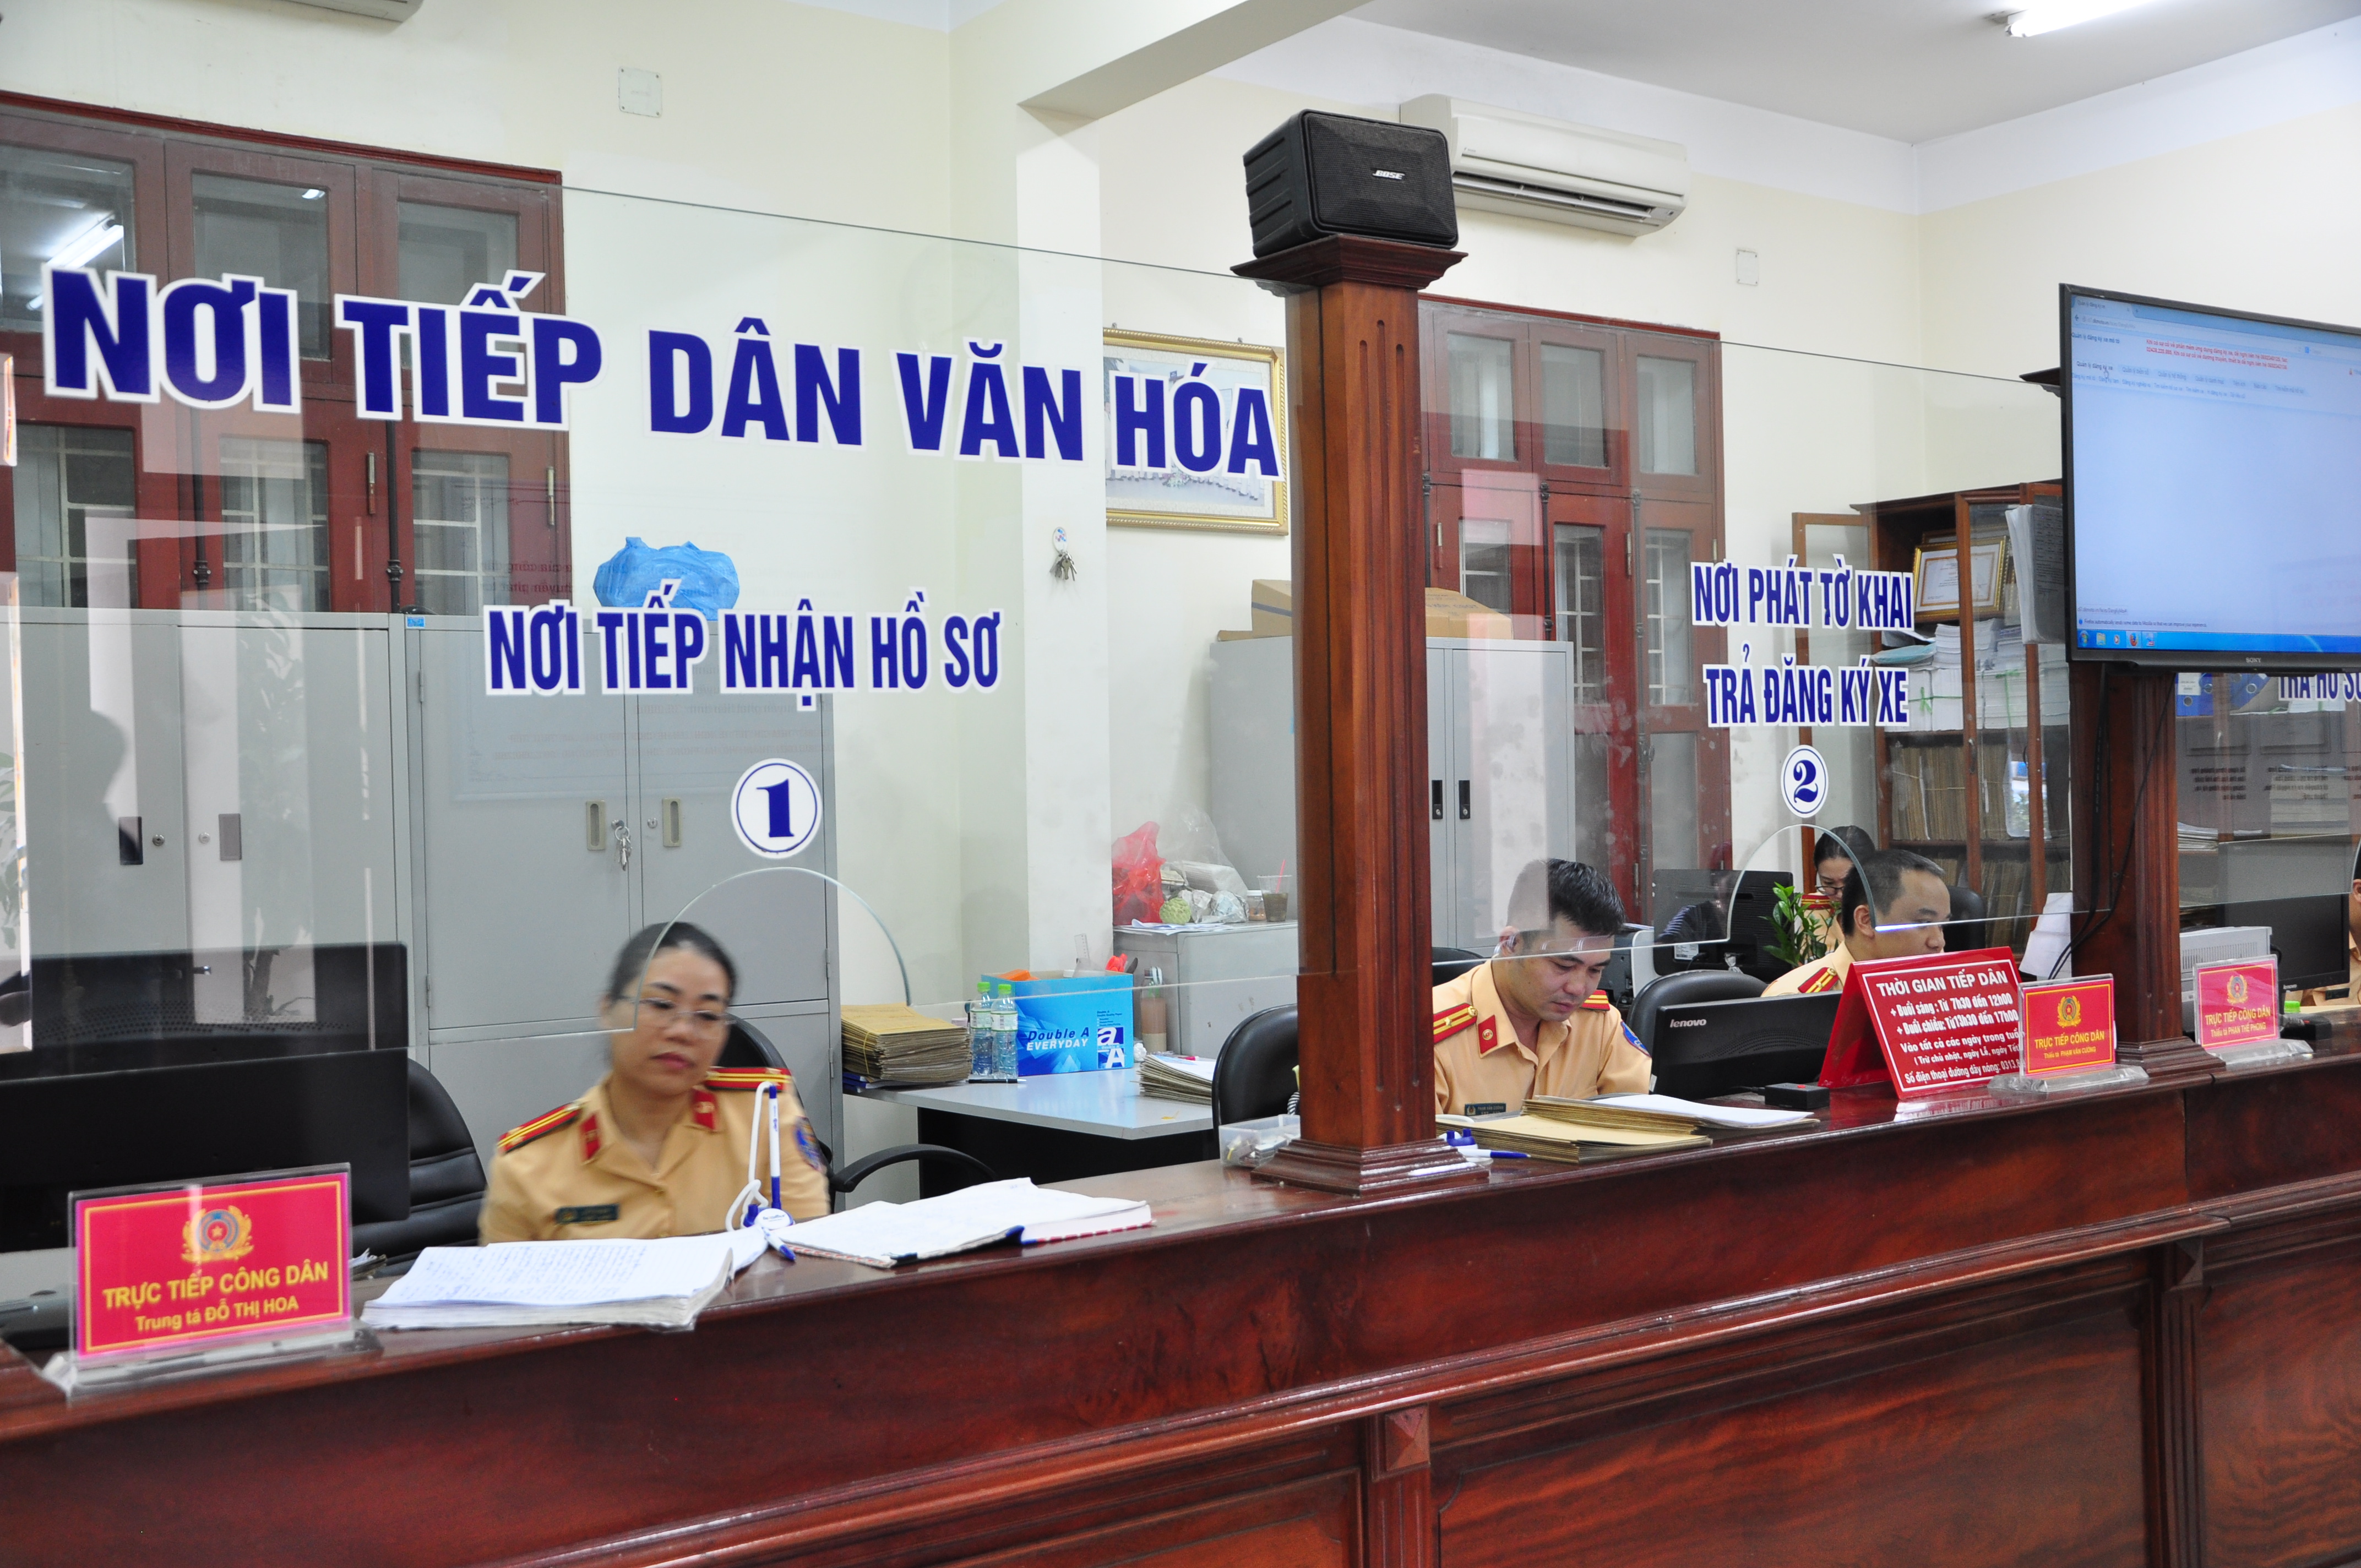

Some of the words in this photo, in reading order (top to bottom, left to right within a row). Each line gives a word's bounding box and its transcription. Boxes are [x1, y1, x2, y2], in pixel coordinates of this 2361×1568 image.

[1373, 170, 1405, 180] BOSE
[51, 269, 293, 406] NƠI
[341, 275, 603, 425] TIẾP
[648, 315, 863, 447] DÂN
[895, 340, 1085, 462] VĂN
[1113, 361, 1281, 478] HÓA
[1693, 560, 1741, 624] NƠI
[1748, 557, 1814, 626] PHÁT
[1819, 557, 1852, 628] TỜ
[1857, 573, 1913, 629] KHAI
[488, 603, 581, 691] NƠI
[595, 582, 704, 690] TIẾP
[722, 597, 856, 708] NHẬN
[870, 590, 929, 690] HỒ
[943, 610, 1002, 689] SƠ
[1705, 642, 1758, 725] TRẢ
[1762, 655, 1834, 724] ĐĂNG
[1840, 656, 1872, 723] KÝ
[1878, 669, 1908, 723] XE
[1792, 759, 1820, 803] 2
[756, 778, 795, 839] 1
[1875, 977, 1911, 997] THỜI
[1912, 977, 1947, 993] GIAN
[1946, 968, 1976, 989] TIẾP
[1977, 967, 2009, 986] DÂN
[1896, 1000, 1915, 1017] Buổi
[1938, 998, 1950, 1012] Từ
[1950, 996, 1972, 1010] 7h30
[1972, 993, 1989, 1008] đến
[1987, 992, 2014, 1006] 12h00
[2205, 1012, 2223, 1027] TRỰC
[2223, 1007, 2238, 1023] TIẾP
[2238, 1007, 2257, 1021] CÔNG
[2257, 1004, 2271, 1018] DÂN
[1028, 1028, 1076, 1041] Double
[1080, 1027, 1090, 1038] A
[1669, 1019, 1707, 1028] lenovo
[1902, 1018, 1922, 1035] Buổi
[1978, 1010, 1994, 1026] đến
[1994, 1009, 2019, 1023] 17h00
[1026, 1038, 1089, 1052] EVERYDAY
[1900, 1042, 1918, 1053] Vào
[1919, 1038, 1933, 1051] tất
[1933, 1037, 1945, 1049] cả
[1946, 1036, 1961, 1047] các
[1962, 1034, 1982, 1047] ngày
[1983, 1032, 2006, 1043] trong
[2034, 1036, 2053, 1050] TRỰC
[2054, 1031, 2069, 1047] TIẾP
[2070, 1031, 2090, 1044] CÔNG
[2091, 1028, 2105, 1042] DÂN
[1930, 1052, 1944, 1063] chủ
[1945, 1051, 1963, 1063] nhật,
[1963, 1048, 1980, 1059] ngày
[1981, 1046, 1991, 1057] Lễ,
[1992, 1045, 2008, 1056] ngày
[1905, 1070, 1916, 1084] Số
[1916, 1070, 1931, 1084] điện
[1930, 1069, 1948, 1082] thoại
[1948, 1066, 1970, 1080] đường
[1970, 1063, 1982, 1075] dây
[1982, 1063, 2001, 1073] nóng:
[102, 1281, 161, 1310] TRỰC
[166, 1268, 214, 1301] TIẾP
[220, 1266, 281, 1294] CÔNG
[285, 1258, 329, 1286] DÂN
[135, 1314, 183, 1332] Trung
[185, 1308, 202, 1326] tá
[204, 1298, 230, 1322] ĐỖ
[233, 1300, 260, 1320] THỊ
[263, 1295, 300, 1314] HOA
